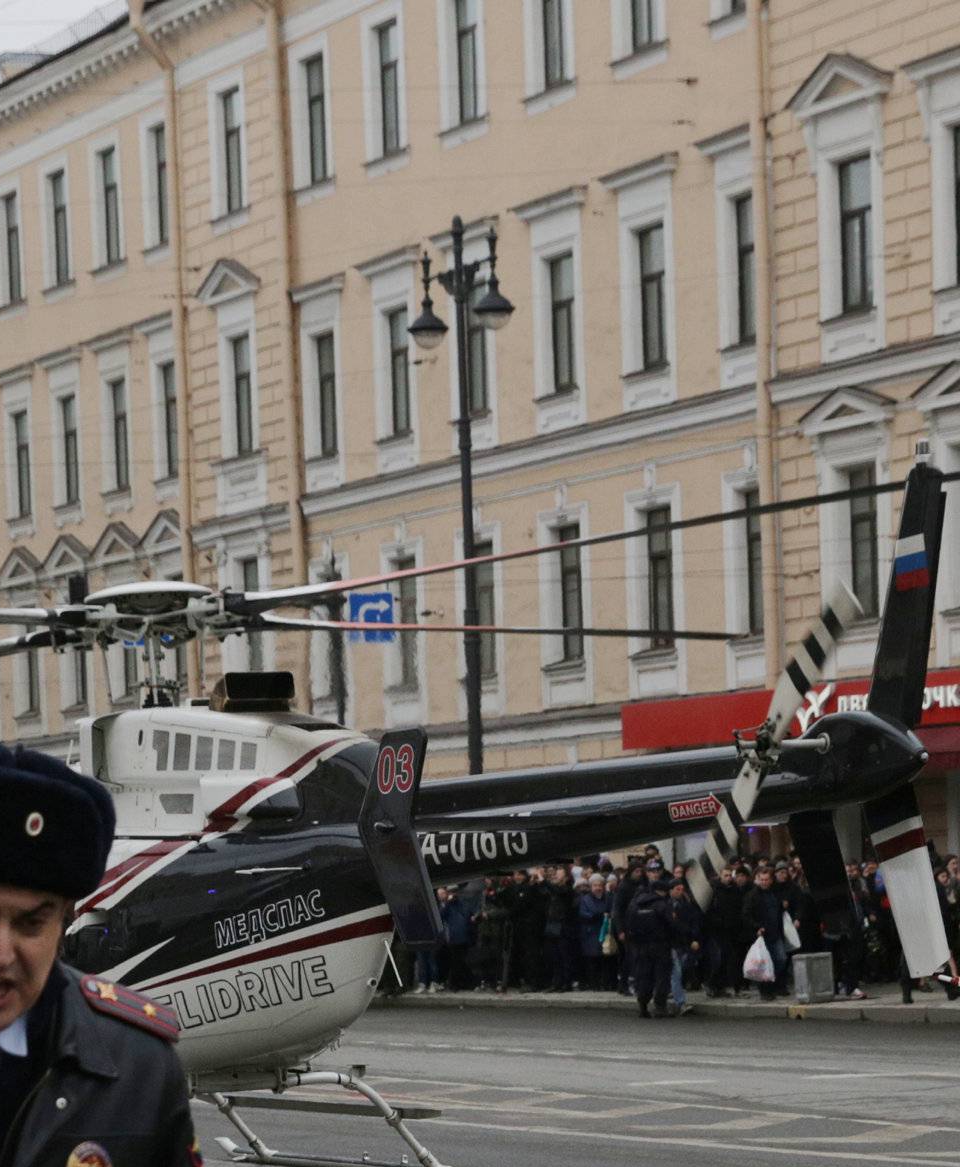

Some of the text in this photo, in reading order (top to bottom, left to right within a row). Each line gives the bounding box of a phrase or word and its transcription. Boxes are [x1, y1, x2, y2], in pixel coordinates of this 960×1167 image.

[377, 743, 415, 795] 03
[671, 801, 717, 818] DANGER
[417, 831, 528, 865] A-01615
[214, 889, 326, 949] МЕДСПАС
